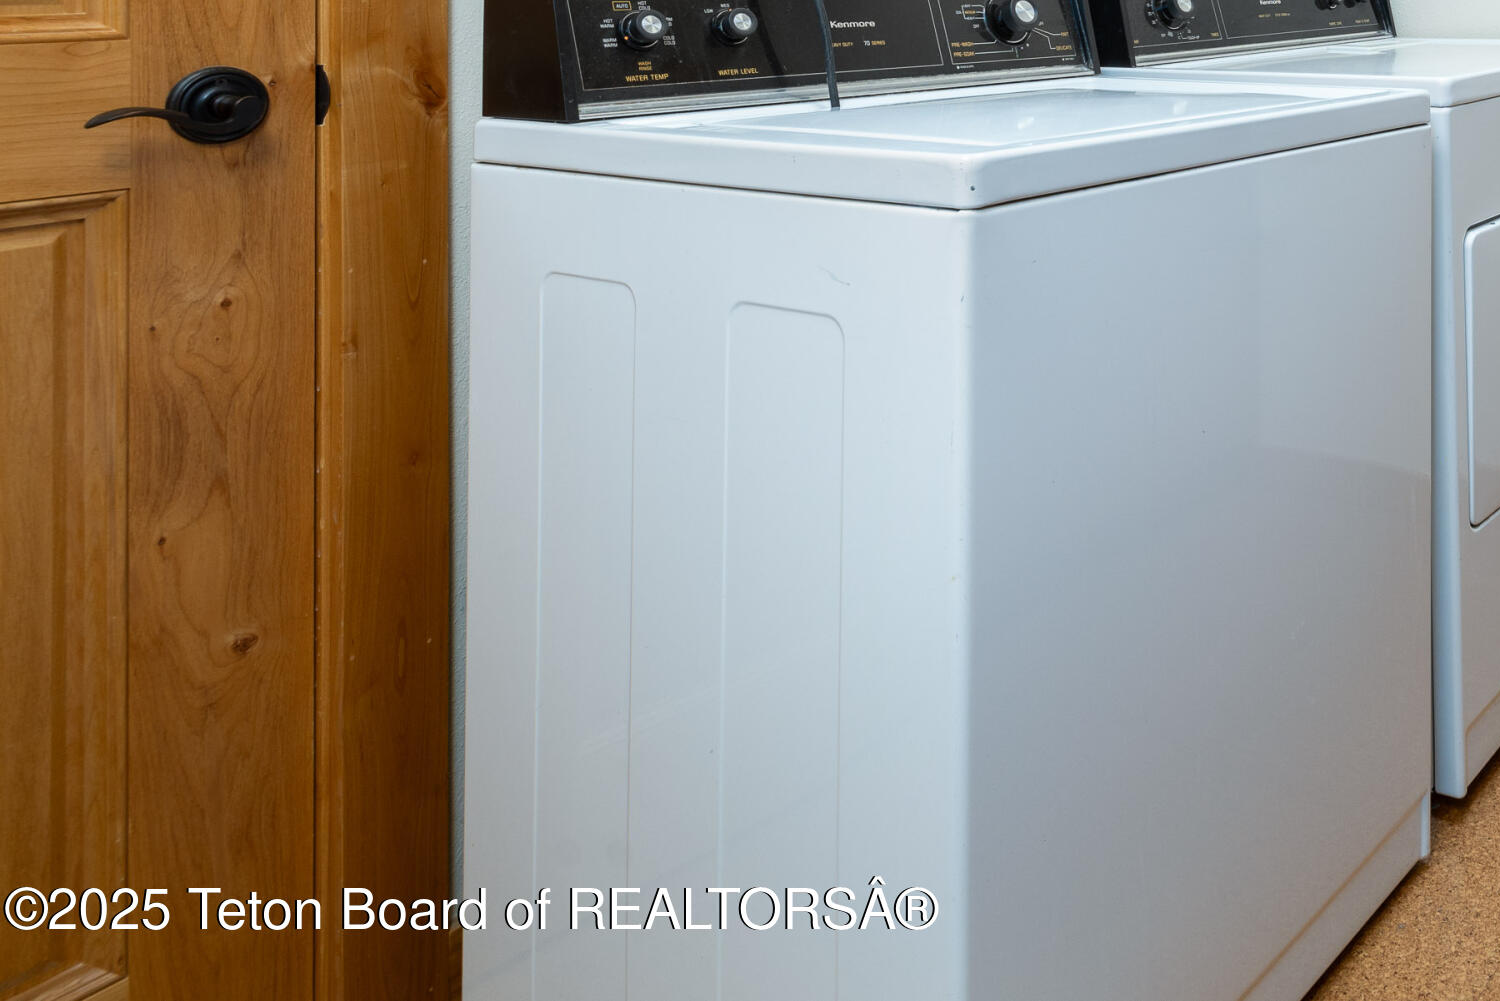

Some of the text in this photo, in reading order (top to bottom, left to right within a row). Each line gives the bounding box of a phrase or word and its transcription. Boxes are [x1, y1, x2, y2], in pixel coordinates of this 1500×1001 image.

[829, 20, 876, 29] Kenmore
[717, 68, 739, 76] WATER
[625, 74, 649, 82] WATER
